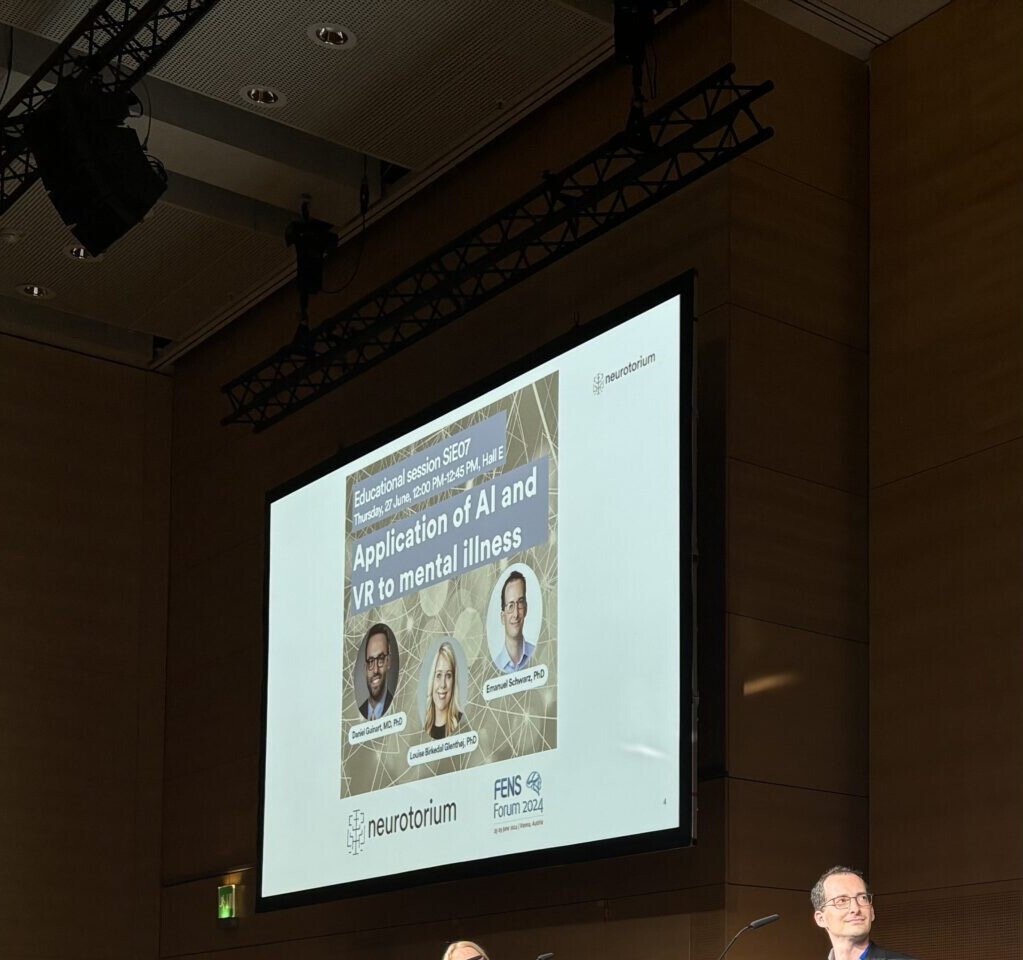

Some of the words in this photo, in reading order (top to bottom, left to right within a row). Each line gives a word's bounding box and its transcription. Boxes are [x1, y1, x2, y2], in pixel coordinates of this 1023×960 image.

[605, 353, 656, 384] neurotorium
[353, 505, 384, 526] Thursday,
[385, 498, 393, 512] 27
[393, 492, 412, 509] June,
[413, 481, 431, 499] 12:00
[466, 457, 481, 474] PM,
[483, 448, 497, 467] Hall
[499, 445, 504, 460] E
[354, 468, 405, 508] Educational
[407, 456, 441, 483] session
[353, 513, 448, 572] Application
[452, 495, 471, 528] of
[476, 485, 496, 520] AI
[502, 466, 537, 508] and
[352, 580, 374, 610] VR
[378, 577, 395, 600] to
[399, 545, 457, 593] mental
[463, 526, 522, 568] illness
[486, 680, 508, 693] Emanuel
[533, 669, 545, 680] PhD
[466, 735, 477, 746] PhD
[494, 774, 522, 800] FENS
[368, 798, 457, 838] neurotorium
[493, 802, 521, 819] Forum
[522, 798, 544, 813] 2024
